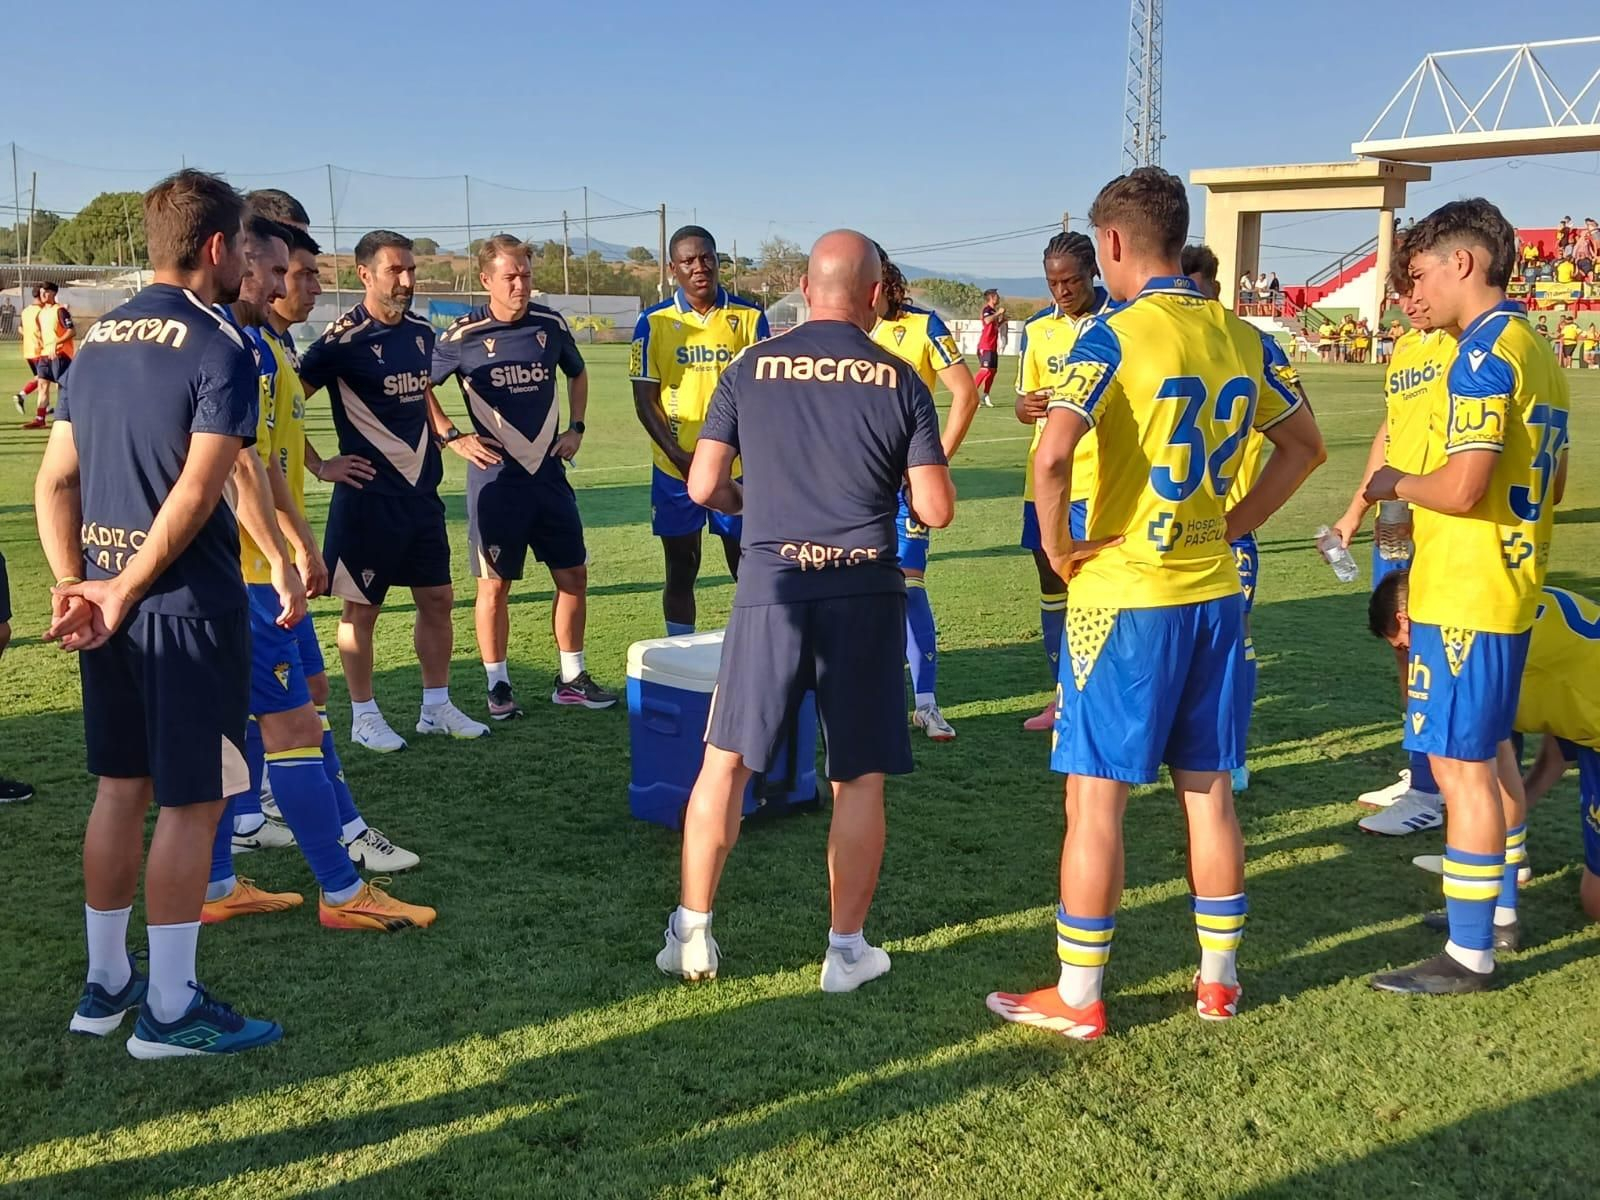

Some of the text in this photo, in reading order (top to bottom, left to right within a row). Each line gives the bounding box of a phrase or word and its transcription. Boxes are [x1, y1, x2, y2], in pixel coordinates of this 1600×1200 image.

[755, 355, 897, 389] macron
[508, 385, 539, 394] Telecom
[1150, 376, 1258, 502] 32
[780, 541, 844, 562] CÁDIZ
